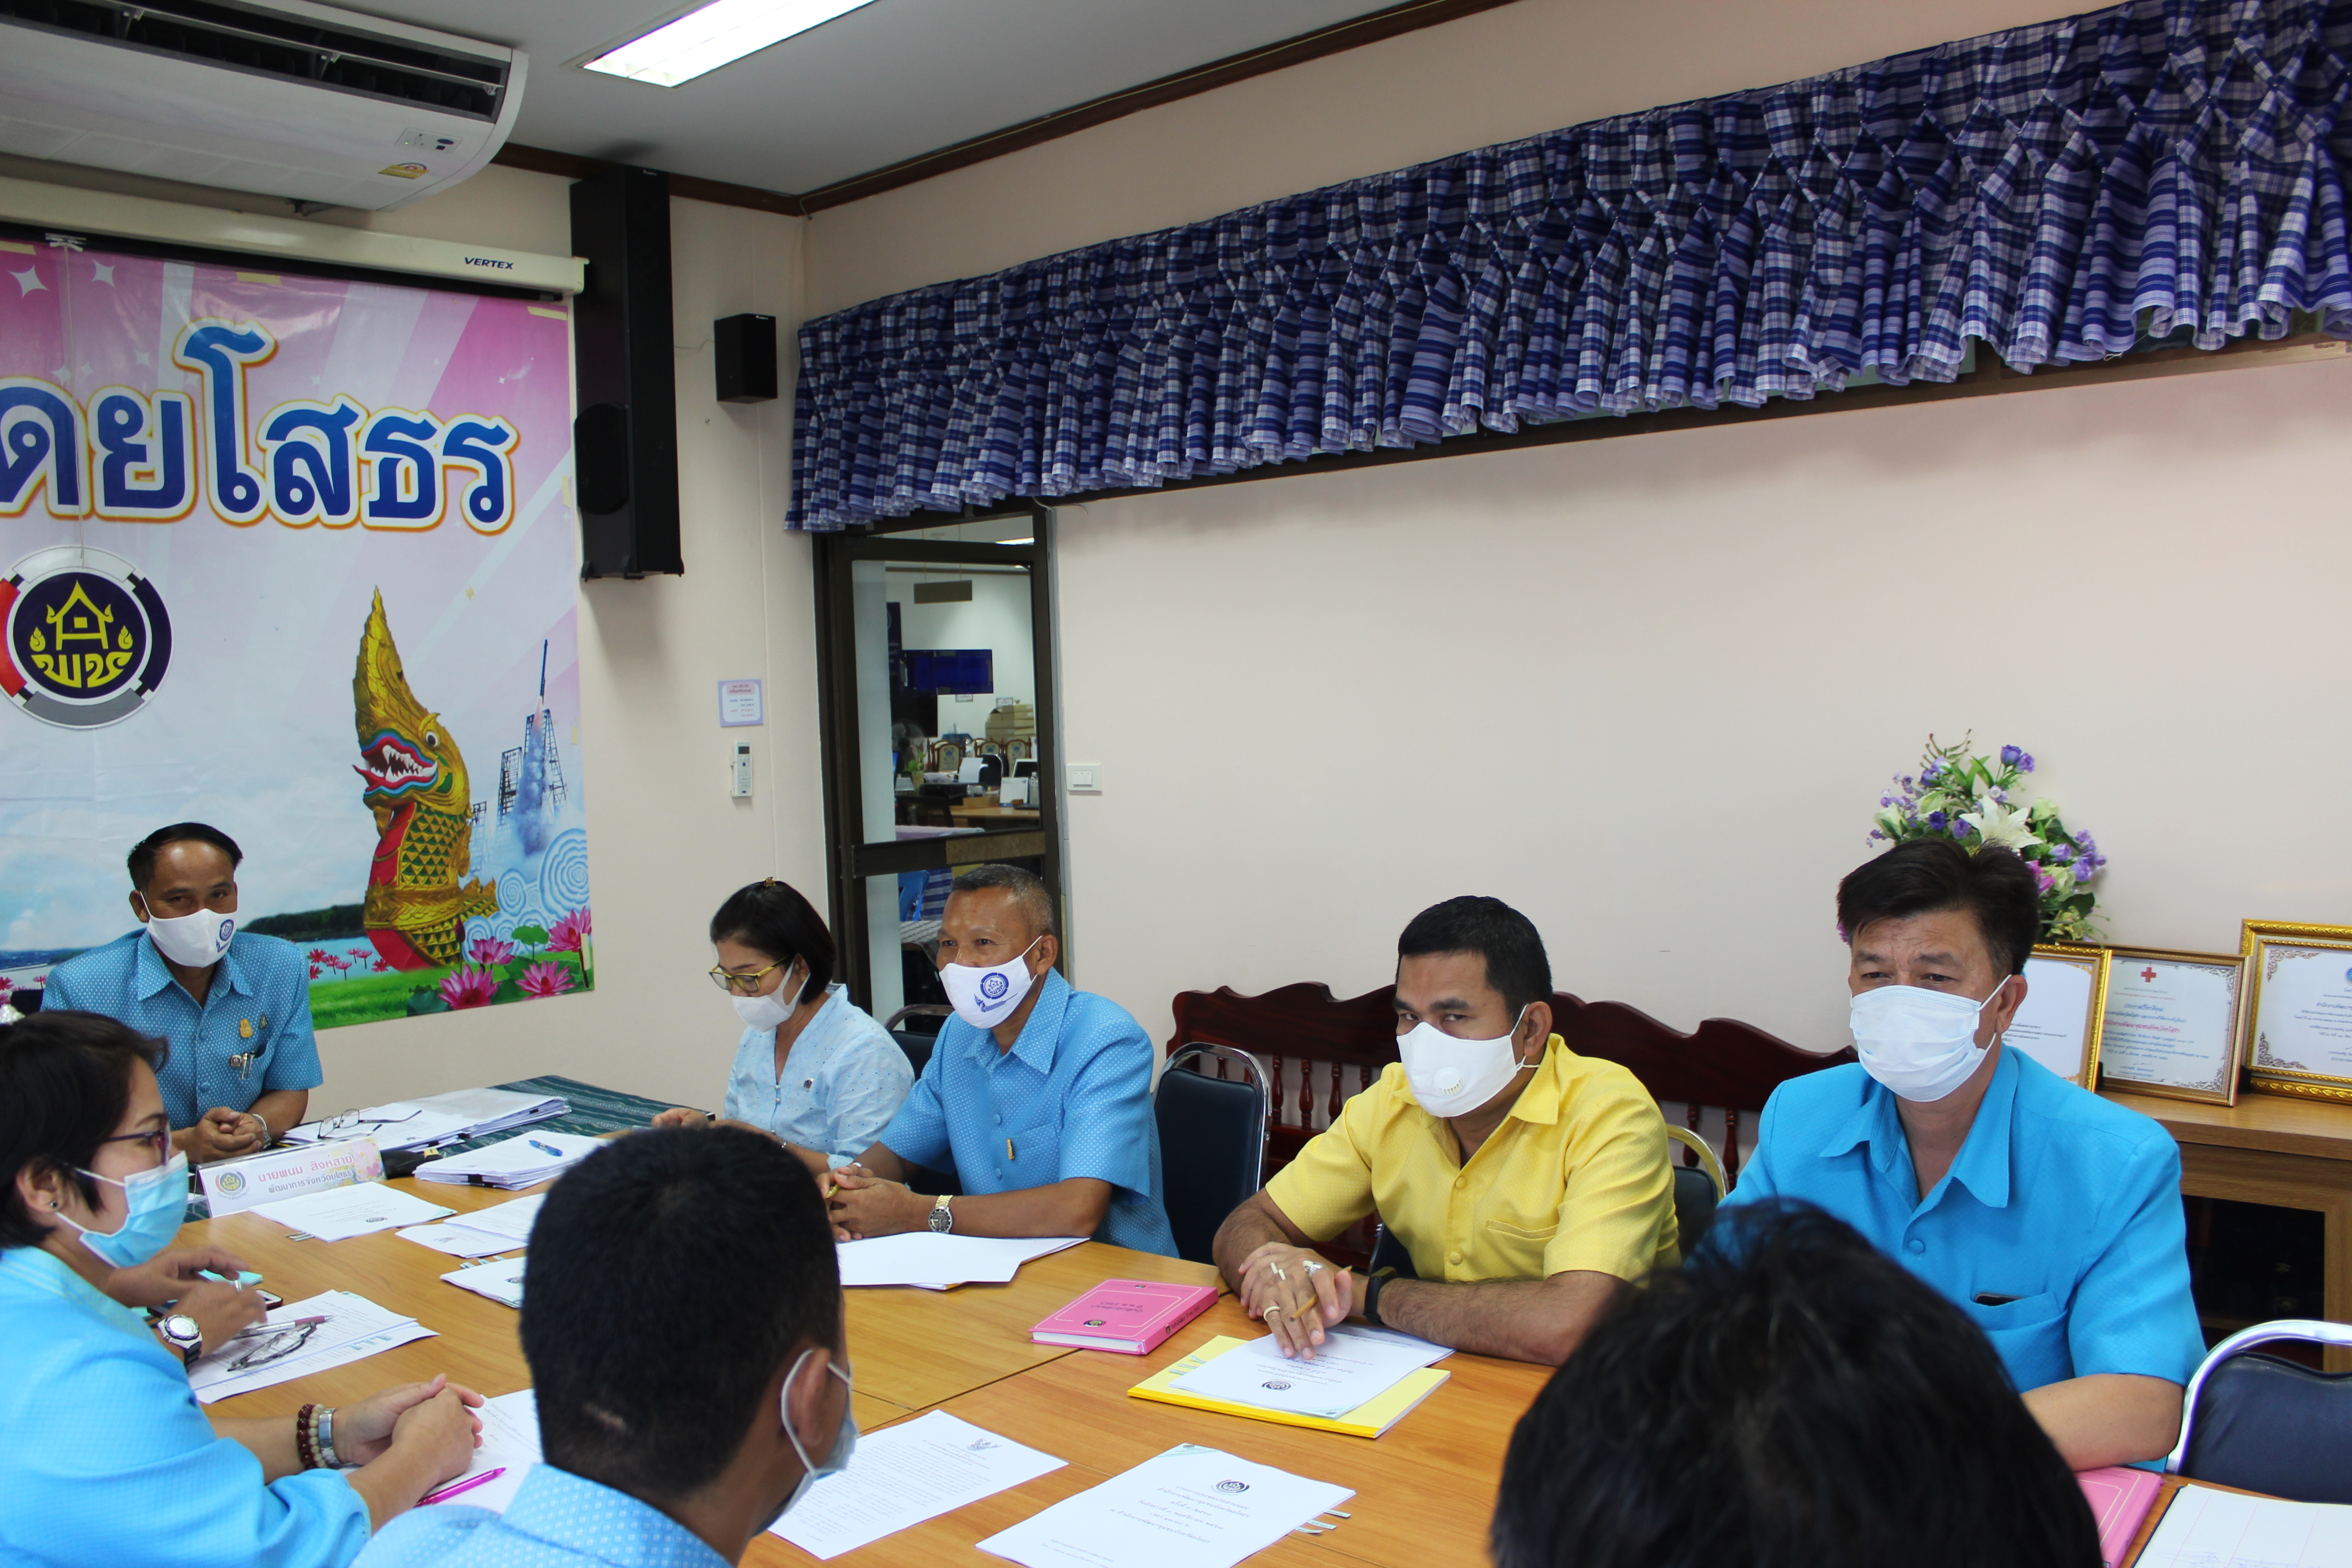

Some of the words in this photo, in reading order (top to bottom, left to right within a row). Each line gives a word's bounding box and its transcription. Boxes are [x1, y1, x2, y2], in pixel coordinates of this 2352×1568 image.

[465, 257, 514, 270] VERTEX
[258, 1166, 304, 1182] นายพนม
[310, 1155, 353, 1171] สิงห์สาย
